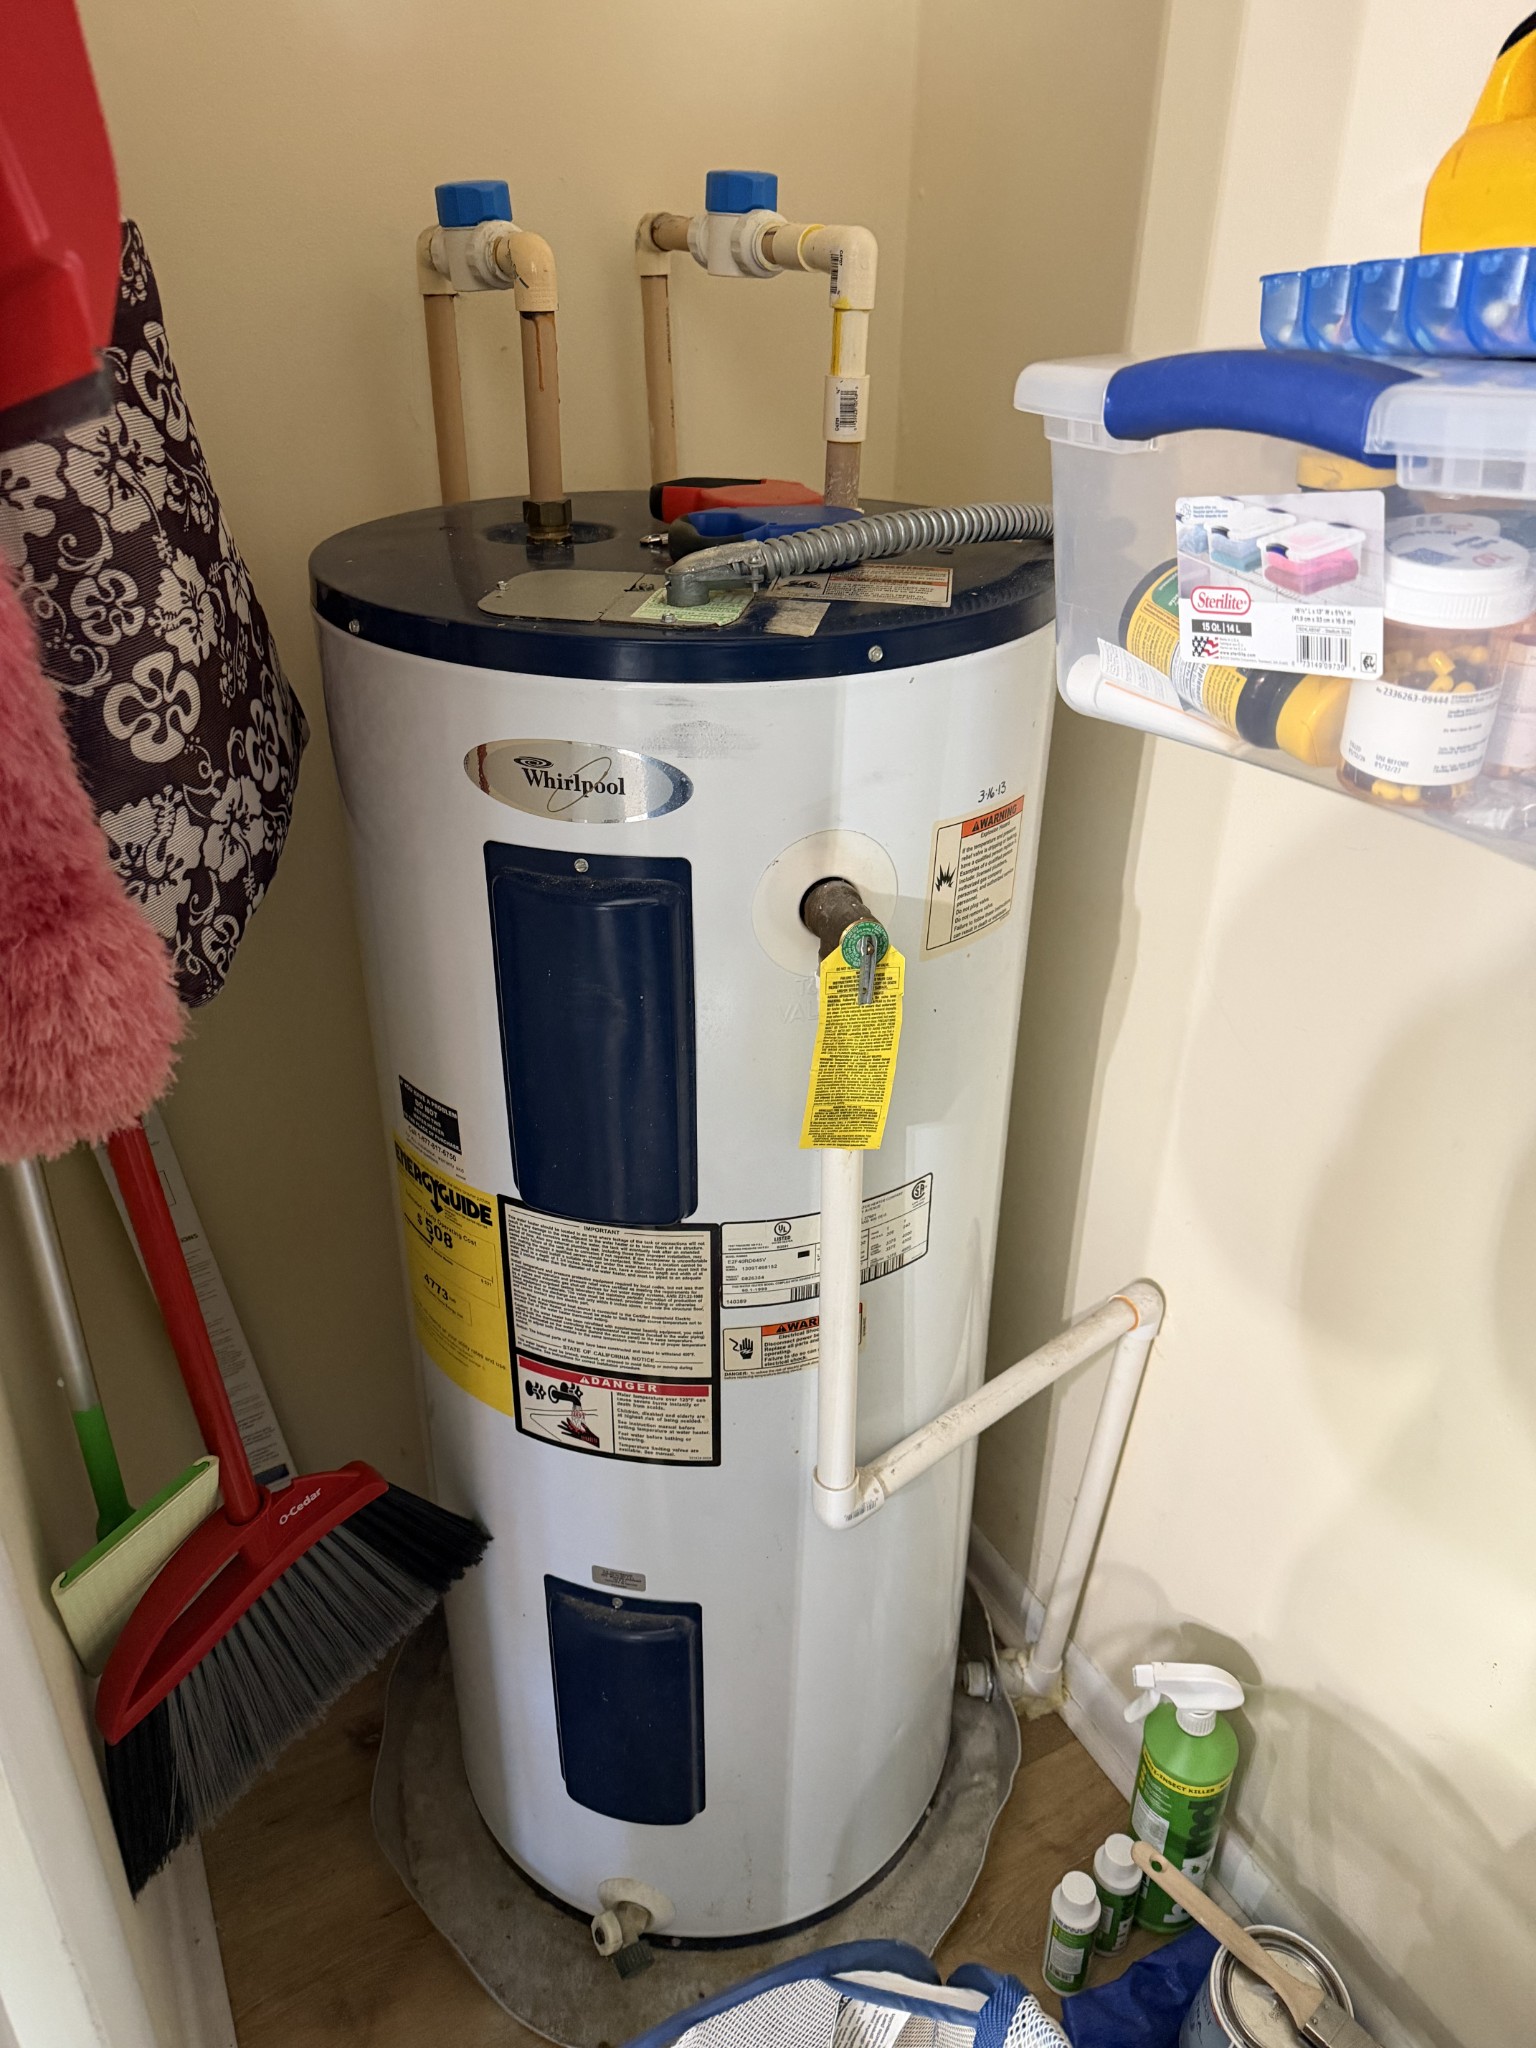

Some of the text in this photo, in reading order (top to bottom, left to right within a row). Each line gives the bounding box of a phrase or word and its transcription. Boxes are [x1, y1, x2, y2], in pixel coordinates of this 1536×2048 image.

[1197, 591, 1243, 611] Sterilite
[1202, 622, 1211, 632] 15
[1226, 624, 1235, 633] 14
[1235, 625, 1241, 634] L
[521, 767, 626, 798] Whirlpool
[980, 803, 1018, 829] WARNING
[425, 1105, 439, 1119] NOT
[417, 1212, 423, 1227] $
[425, 1217, 453, 1249] 508
[583, 1225, 620, 1236] IMPORTANT
[424, 1273, 449, 1301] 4773
[764, 1338, 795, 1347] Disconnect
[764, 1344, 786, 1352] Replace
[562, 1344, 581, 1353] STATE
[593, 1350, 630, 1360] CALIFORNIA
[764, 1355, 783, 1363] Failure
[484, 1356, 495, 1365] and
[764, 1359, 789, 1367] electrical
[591, 1377, 657, 1393] DANGER
[279, 1487, 322, 1526] O-Cedar
[1188, 1787, 1216, 1795] KILLER
